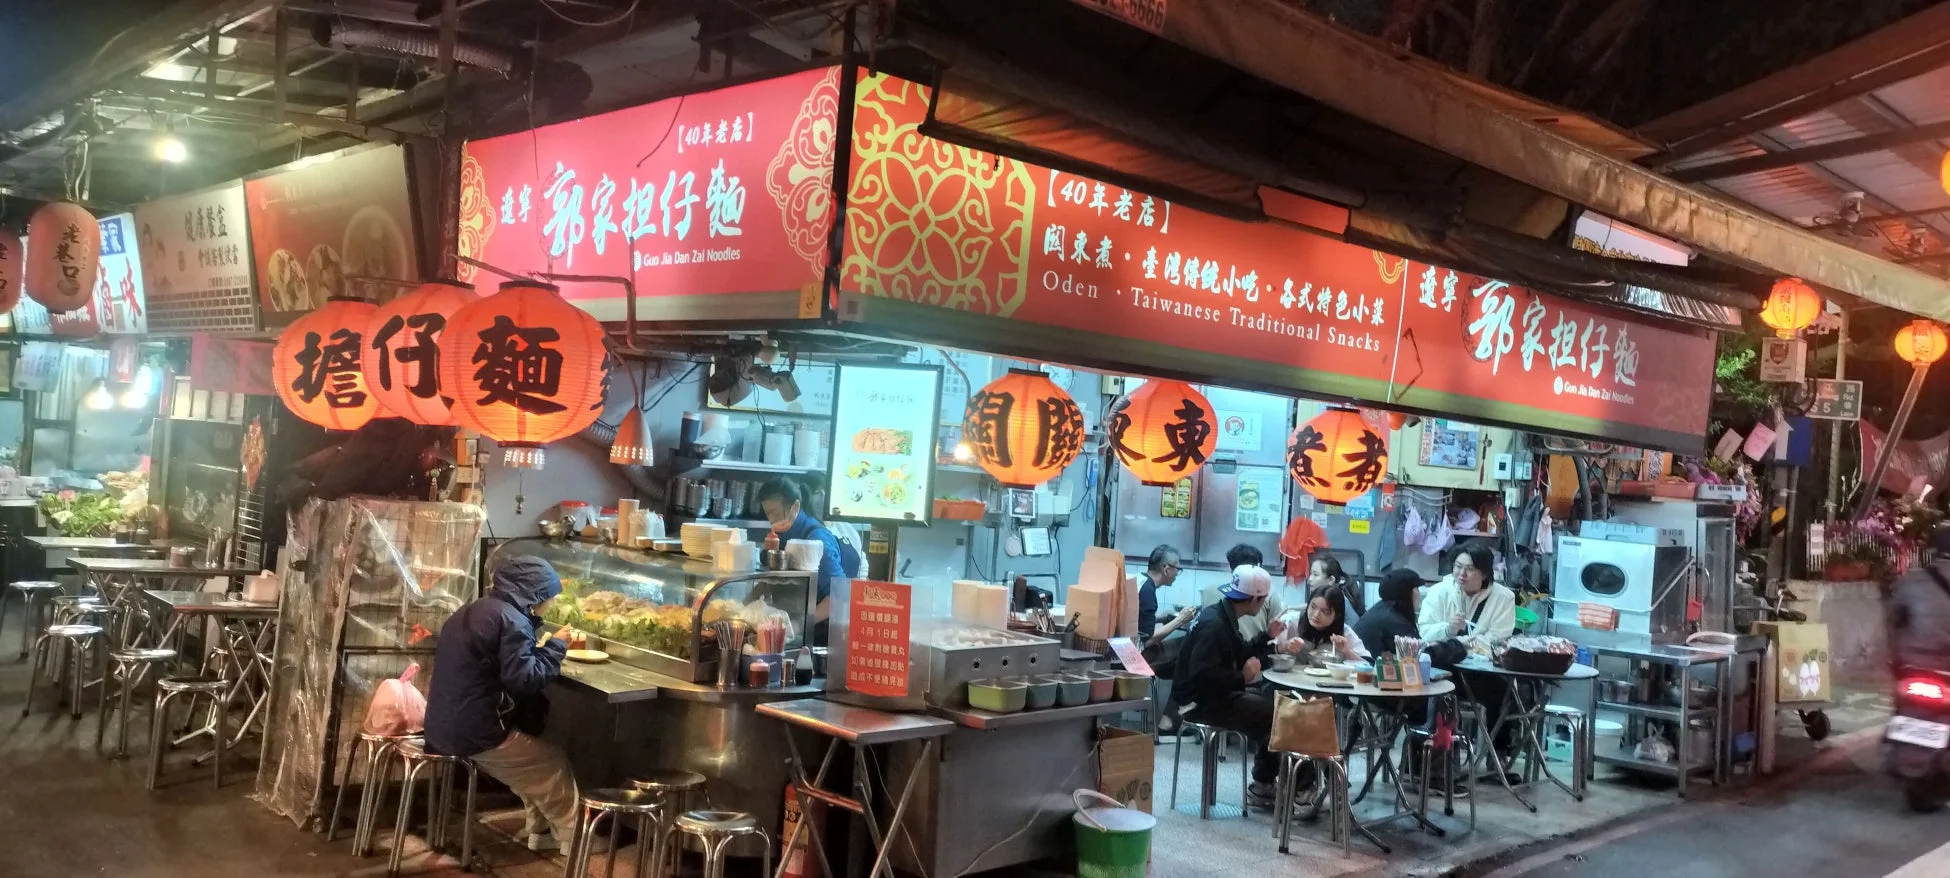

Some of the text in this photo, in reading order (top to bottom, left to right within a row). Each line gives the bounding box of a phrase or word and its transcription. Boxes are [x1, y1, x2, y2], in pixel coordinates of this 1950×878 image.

[677, 112, 754, 154] 【40年老店】
[501, 184, 532, 225] 遼寧
[1047, 168, 1171, 234] 【40年老店】
[643, 246, 741, 267] Guo Jia Dan Zai Noodles
[1043, 270, 1380, 352] Oden Taiwanese Traditional Snacks
[1419, 265, 1459, 312] 遼寧
[372, 313, 447, 399] 仔
[471, 315, 567, 415] 麵
[1564, 380, 1578, 394] Guo
[1588, 386, 1601, 399] Dan
[1143, 399, 1211, 472] 東
